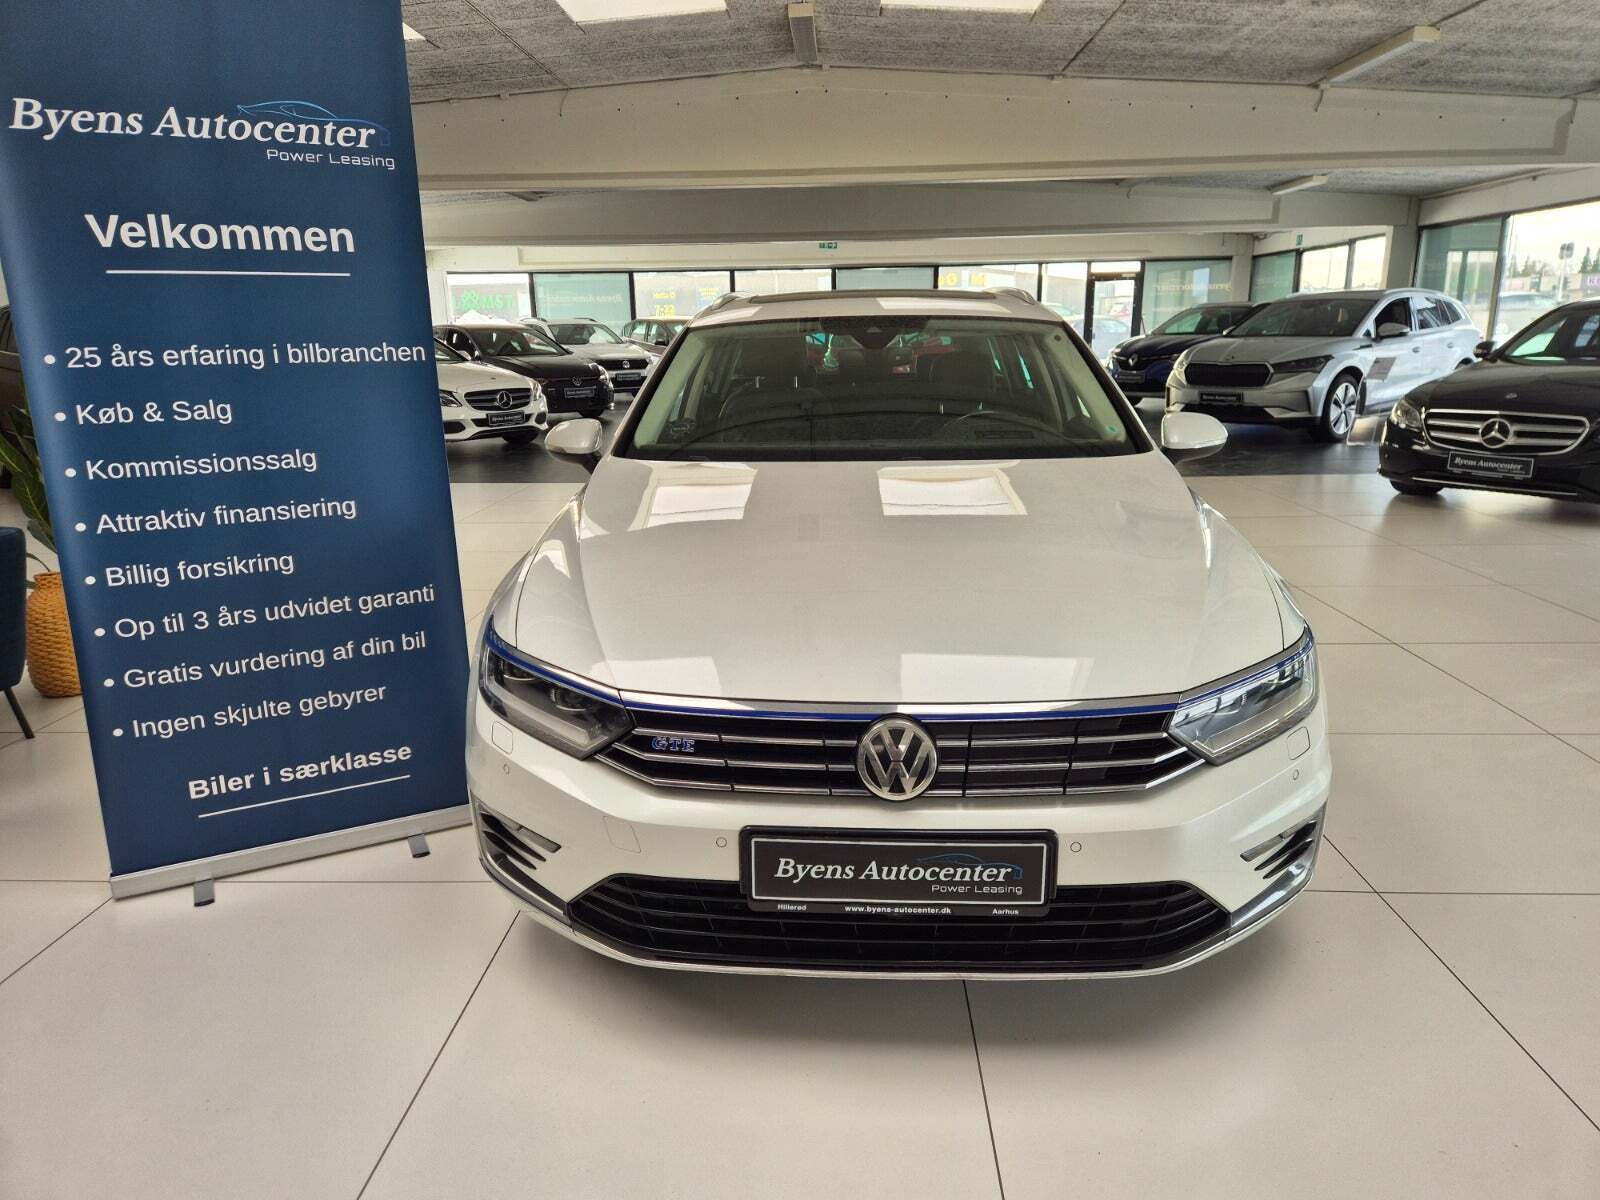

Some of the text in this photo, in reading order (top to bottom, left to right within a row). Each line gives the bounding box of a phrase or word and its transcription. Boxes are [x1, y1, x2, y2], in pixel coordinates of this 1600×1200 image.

[8, 97, 376, 148] Byens Autocenter
[266, 149, 395, 170] Power Leasing
[84, 213, 355, 253] Velkommen
[65, 342, 426, 370] 25 års erfaring i bilbranchen
[76, 399, 233, 425] Køb & Salg
[85, 448, 317, 480] Kommissionssalg
[96, 497, 357, 534] Attraktiv finansiering
[105, 553, 294, 588] Billig forsikring
[114, 583, 436, 641] Op til 3 års udvidet garanti
[123, 631, 426, 688] Gratis vurdering af din bil
[132, 686, 386, 739] Ingen skjulte gebyrer
[651, 735, 695, 752] GTE
[188, 746, 412, 800] Biler i særklasse
[773, 857, 1012, 884] Byens Autocenter
[931, 884, 1024, 895] Power Leasing
[844, 904, 952, 915] www.byens-autocenter.dk
[992, 907, 1020, 915] Aarhus
